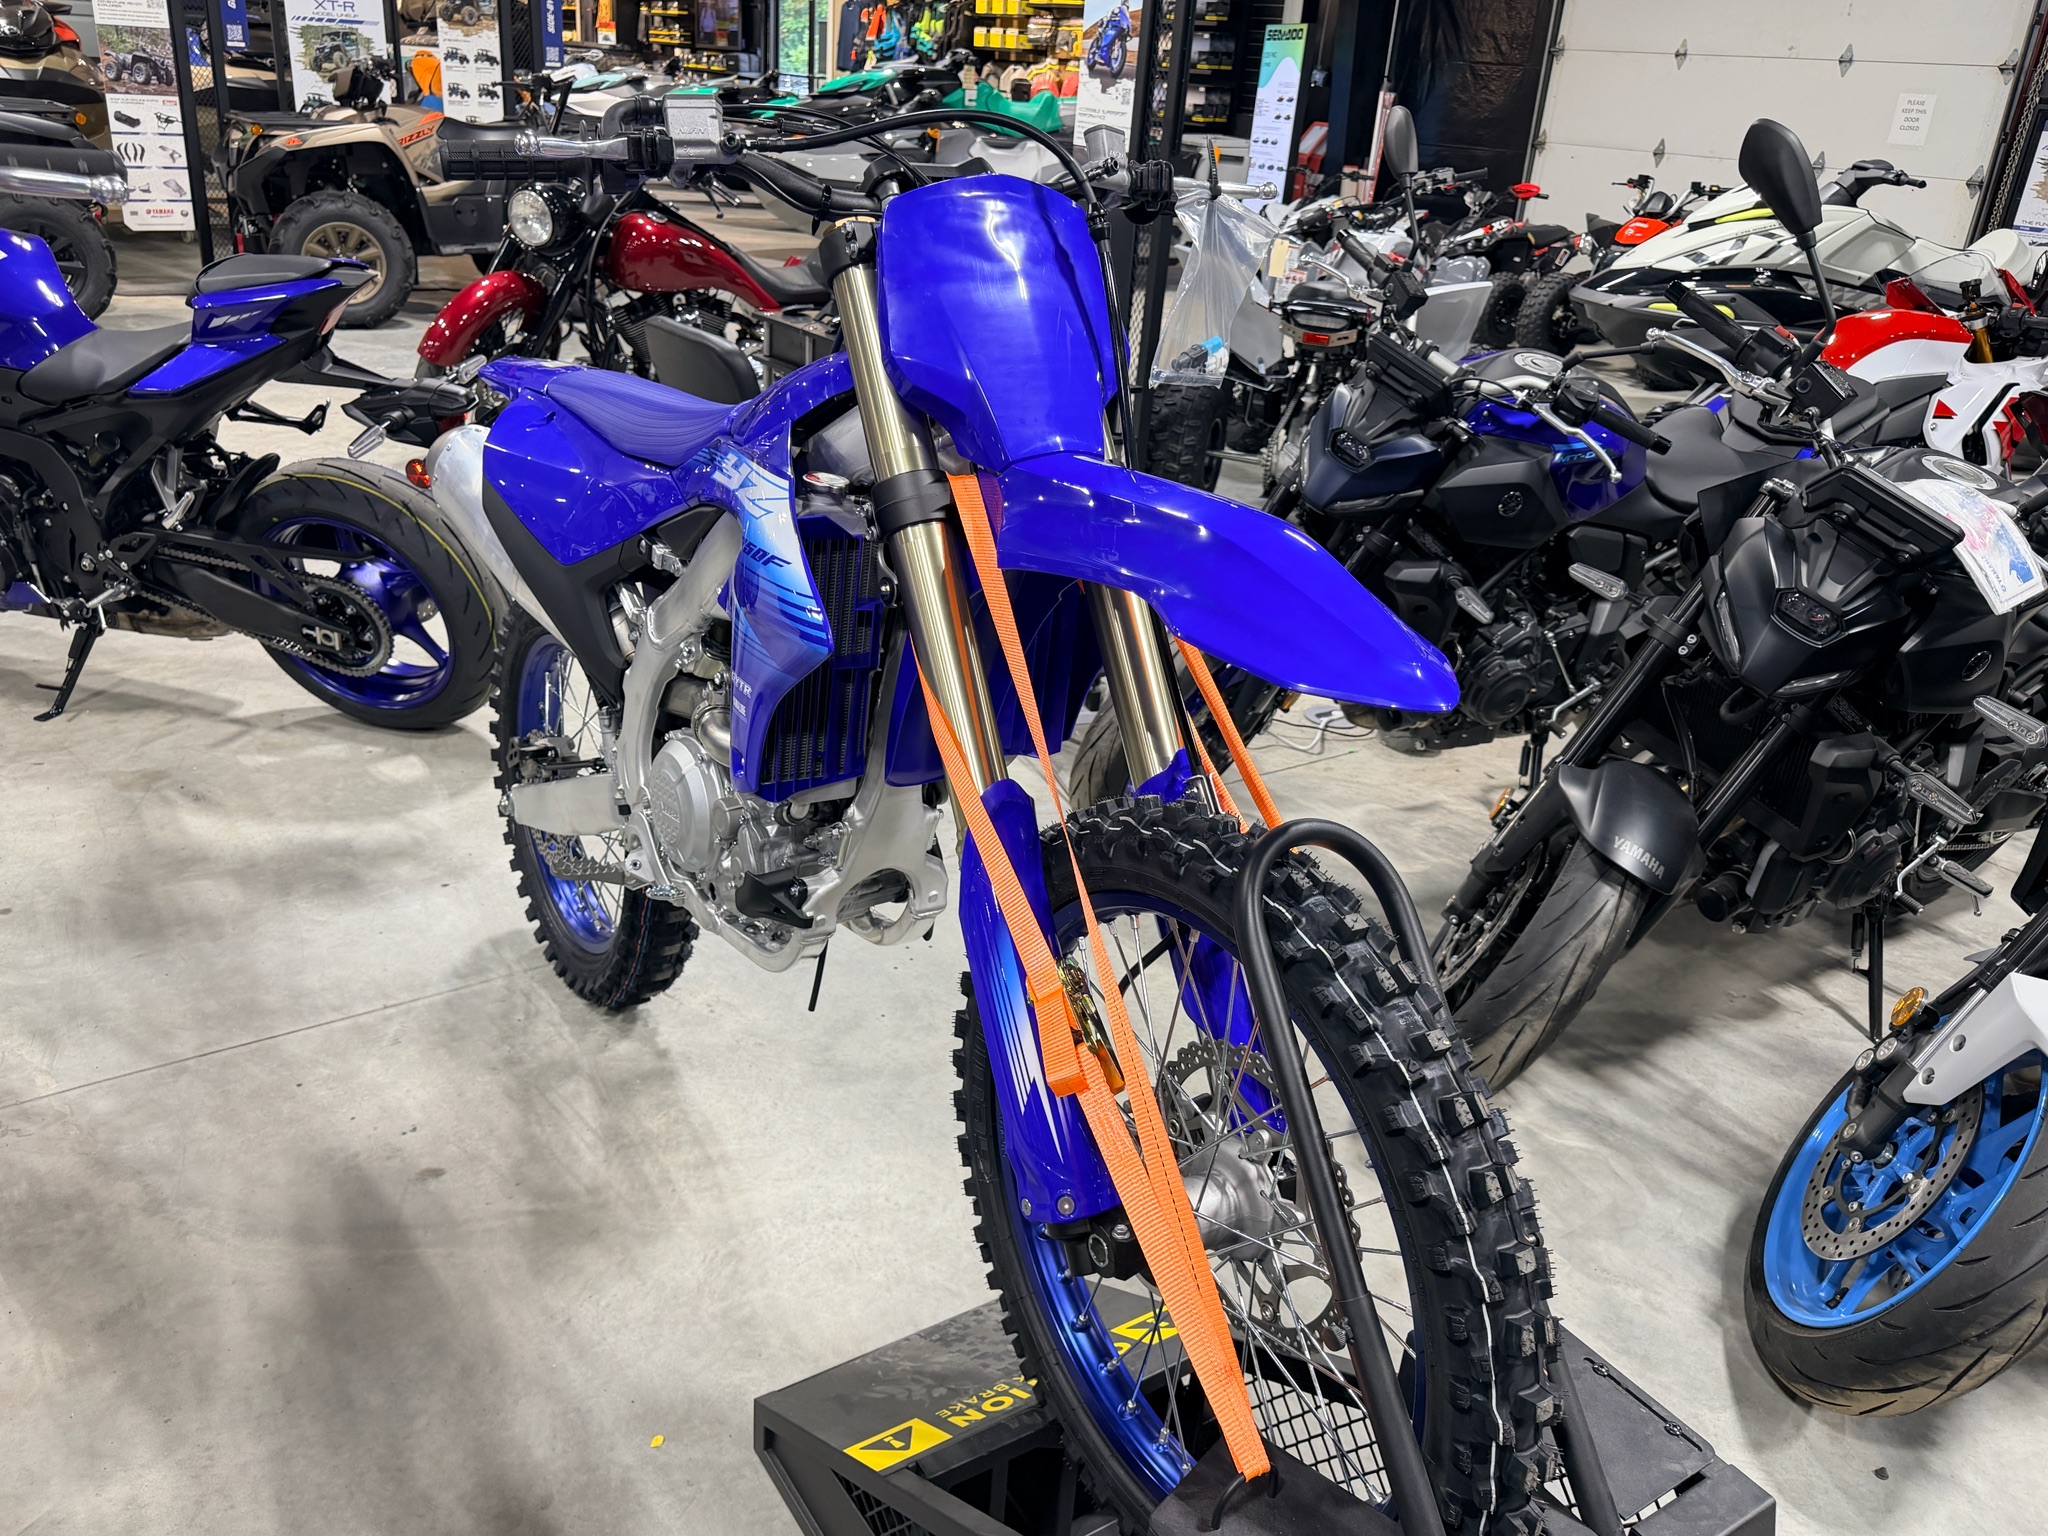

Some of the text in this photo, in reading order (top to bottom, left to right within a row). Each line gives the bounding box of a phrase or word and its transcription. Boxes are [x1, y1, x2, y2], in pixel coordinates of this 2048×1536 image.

[398, 125, 435, 147] RIZZLY
[1613, 835, 1665, 880] YAMAHA
[934, 1383, 1010, 1419] BRAKE
